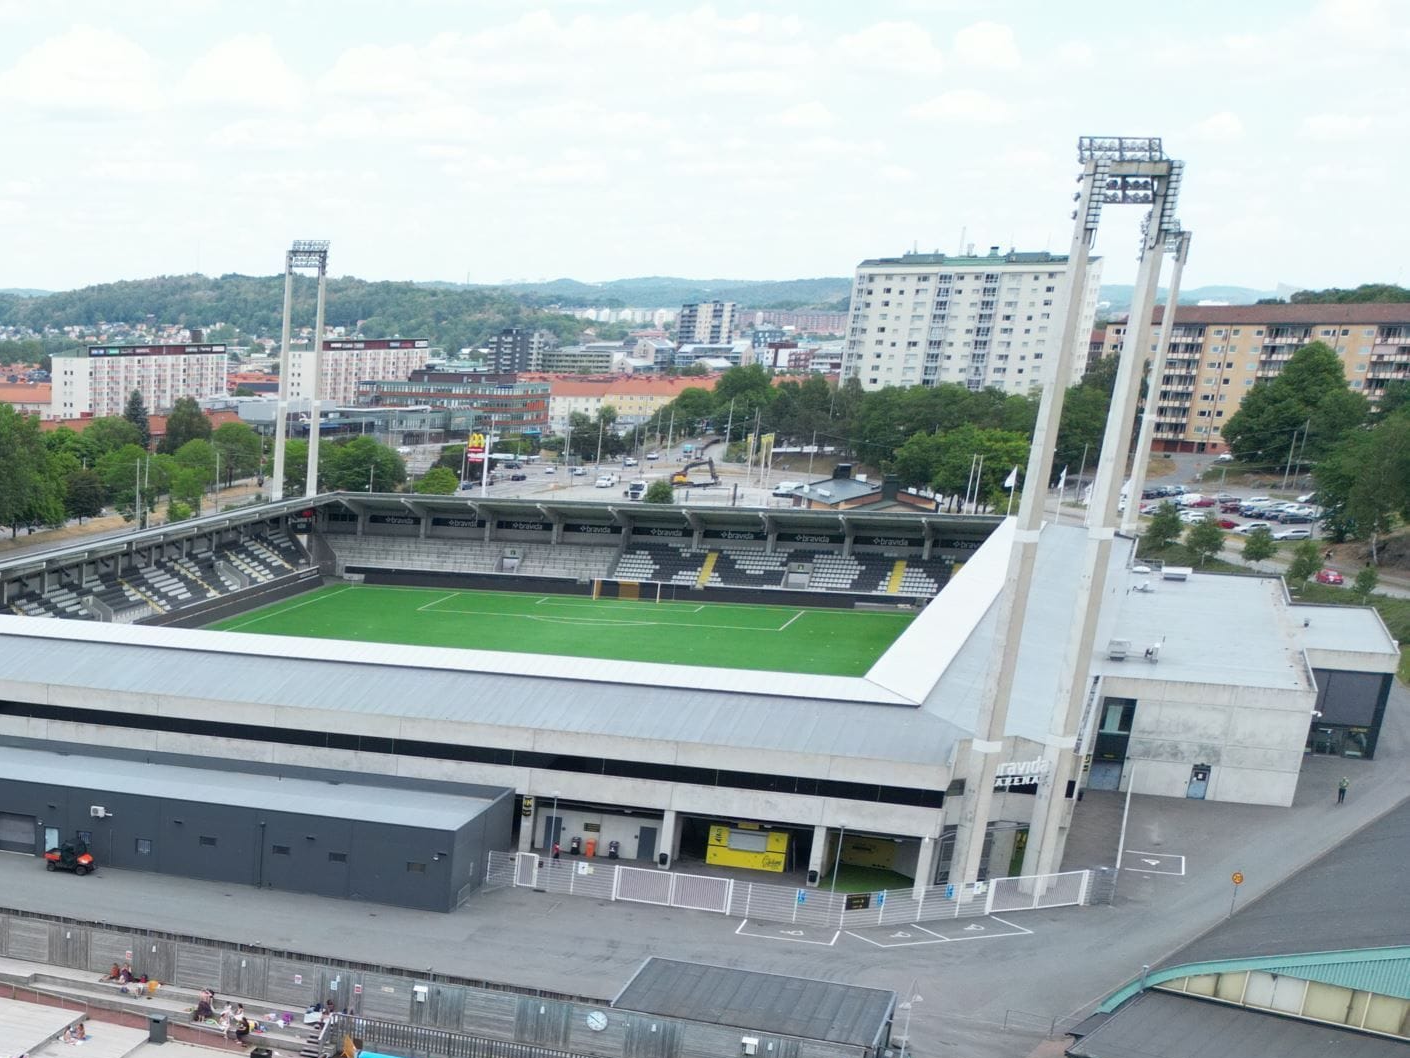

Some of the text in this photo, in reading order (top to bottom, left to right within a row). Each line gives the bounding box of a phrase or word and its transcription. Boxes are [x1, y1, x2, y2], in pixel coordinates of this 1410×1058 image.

[454, 520, 478, 528] bravida
[518, 523, 543, 531] bravida
[586, 526, 610, 534] bravida
[657, 529, 683, 537] bravida
[727, 532, 754, 540] bravida
[802, 534, 830, 544] bravida
[880, 538, 909, 547] bravida
[994, 775, 1039, 787] ARENA
